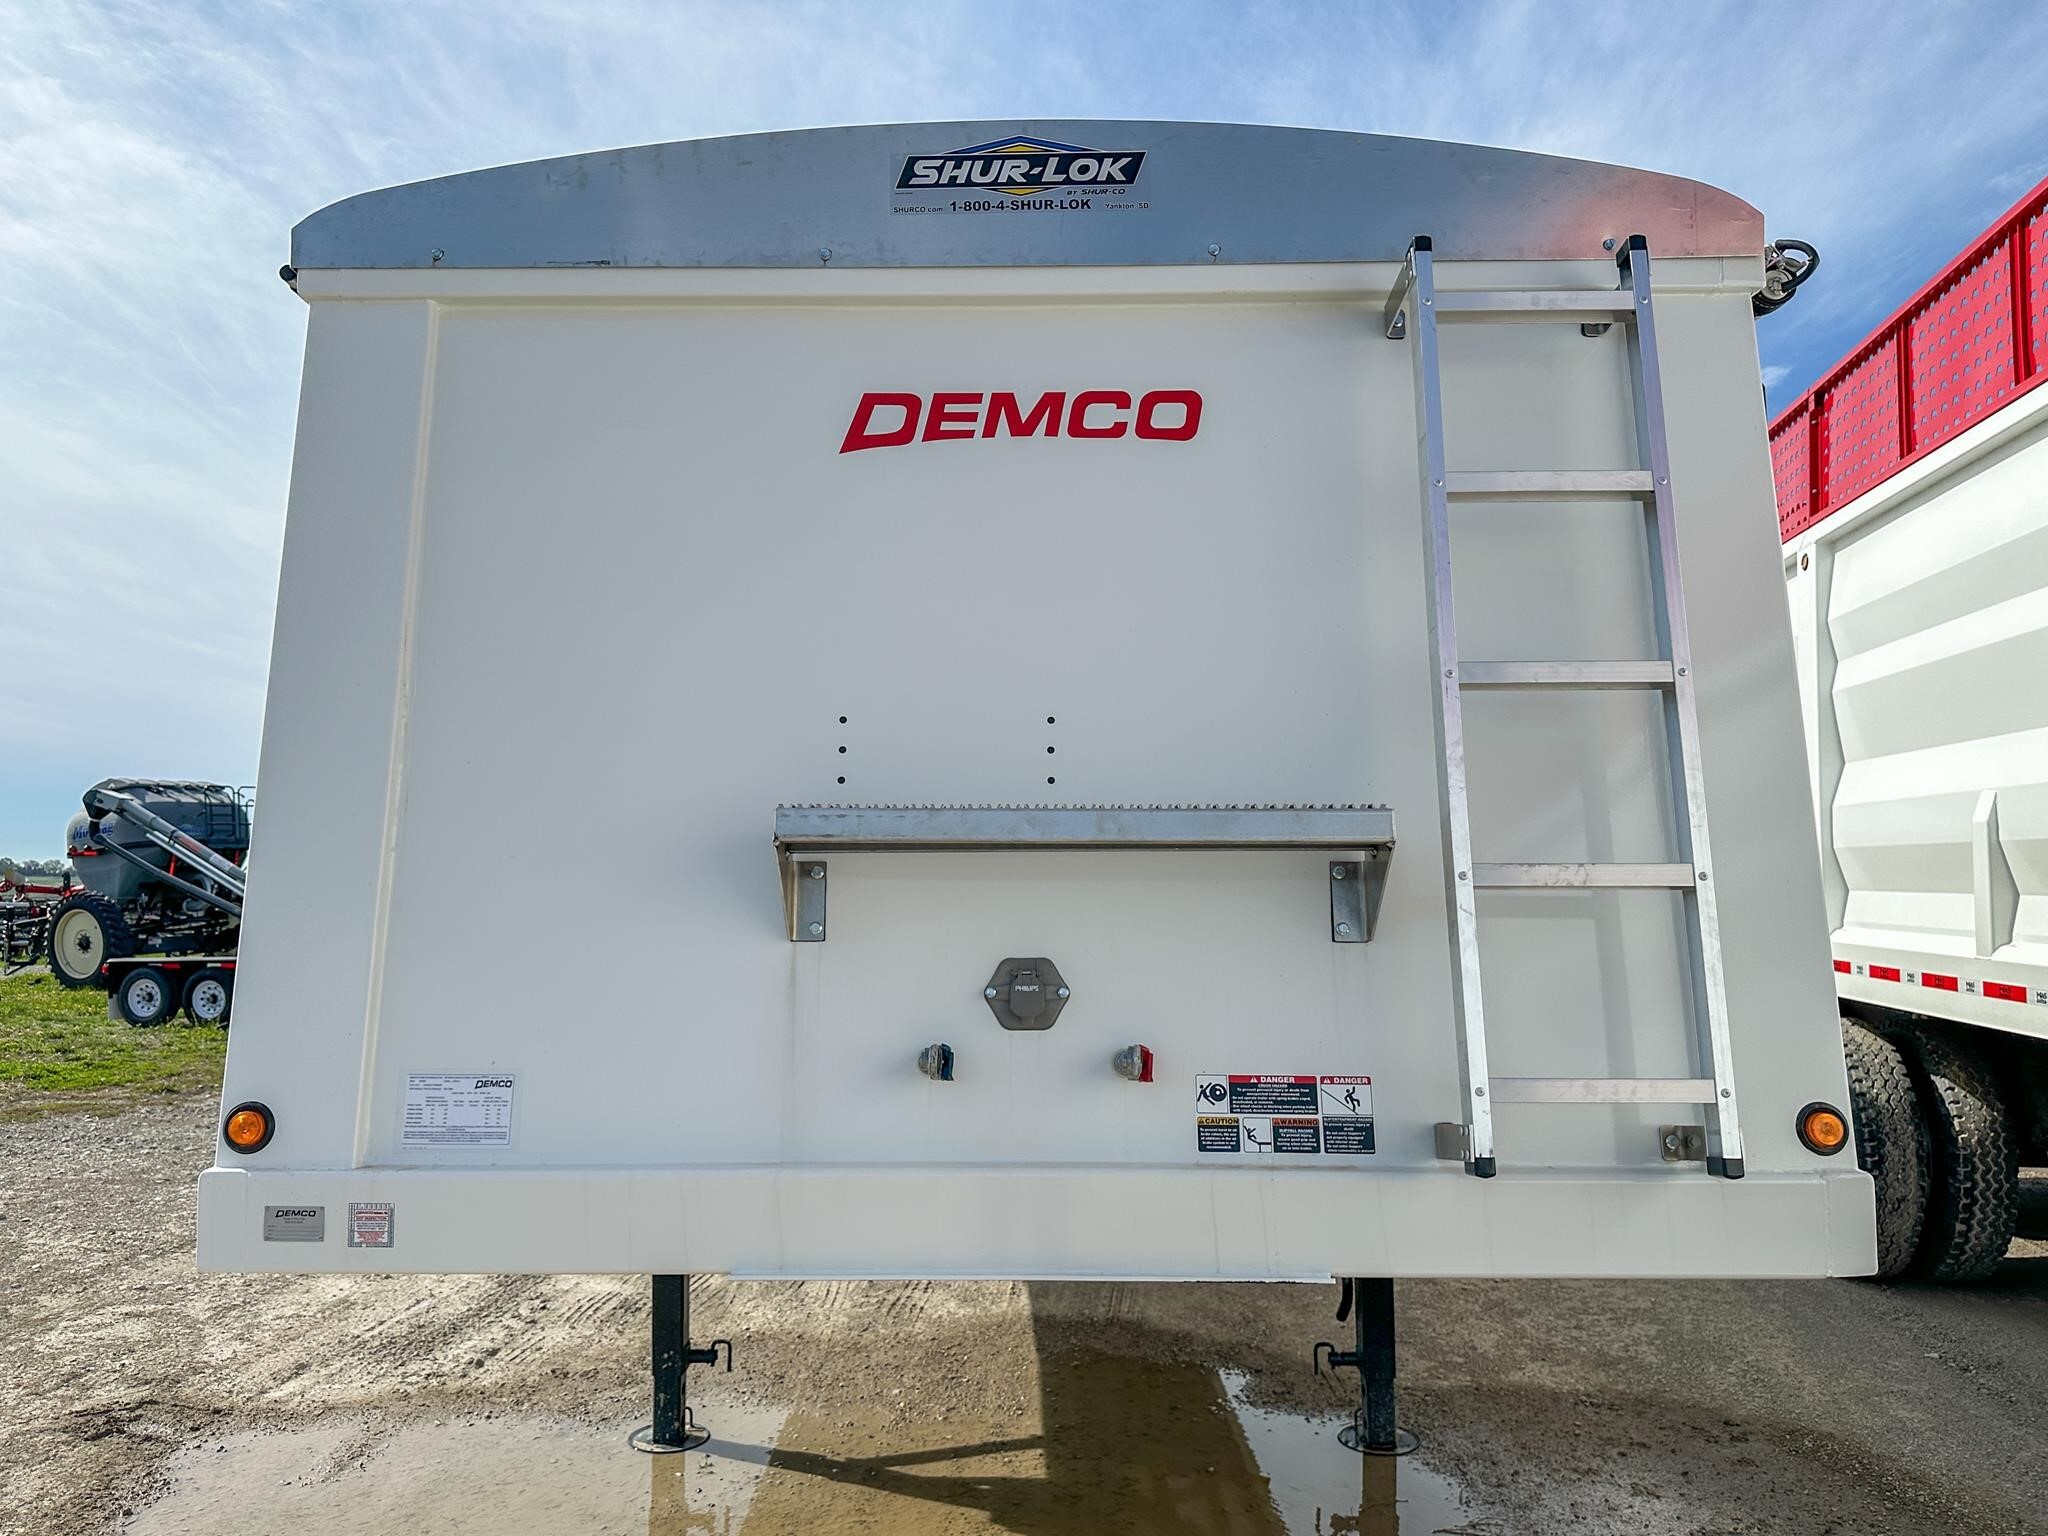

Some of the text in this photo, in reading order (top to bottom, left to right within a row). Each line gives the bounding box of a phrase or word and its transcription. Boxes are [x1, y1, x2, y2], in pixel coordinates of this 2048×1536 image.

[908, 157, 1132, 185] SHUR-LOK
[950, 198, 1092, 212] 1-800-4-SHUR-LOK
[839, 390, 1203, 455] DEMCO
[474, 1080, 513, 1089] DEMCO
[275, 1209, 317, 1218] DEMCO
